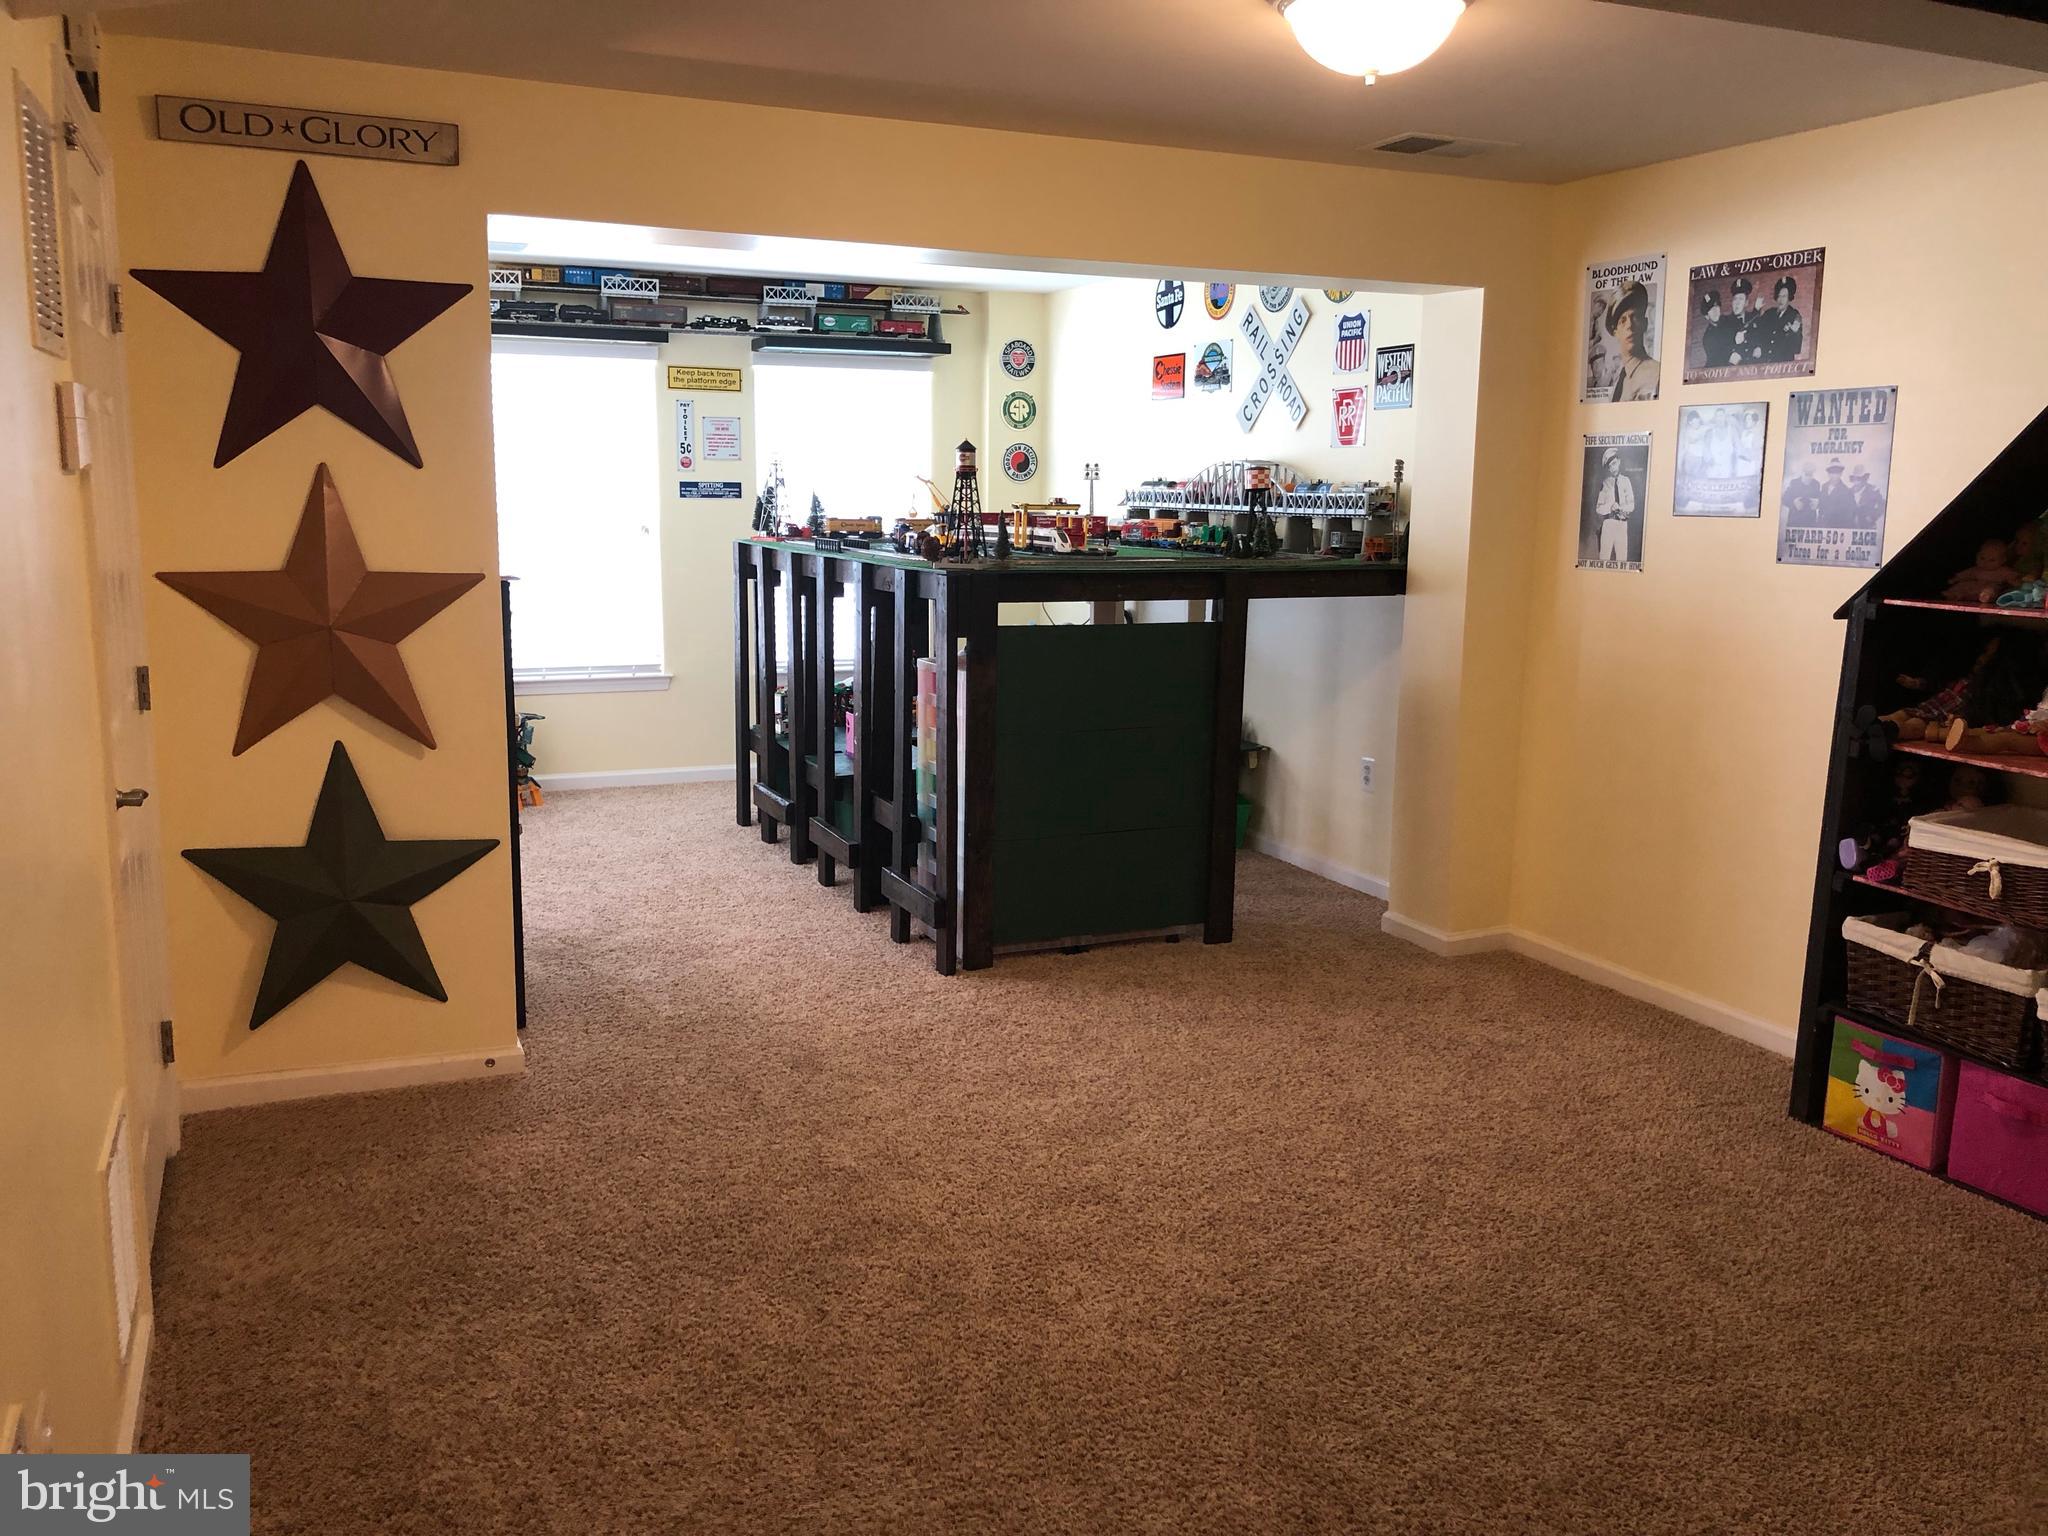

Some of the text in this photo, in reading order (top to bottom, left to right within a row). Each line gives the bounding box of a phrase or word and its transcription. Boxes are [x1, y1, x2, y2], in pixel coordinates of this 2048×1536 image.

[179, 103, 439, 155] OLD GLORY
[1592, 260, 1658, 279] BLOODHOUND
[1690, 264, 1718, 280] LAW
[1720, 263, 1730, 276] &
[1595, 279, 1608, 289] OF
[1156, 288, 1184, 309] Santa Fe
[1342, 319, 1362, 329] UNION
[1341, 328, 1363, 338] PACIFIC
[1005, 341, 1033, 356] SEABOARD
[676, 368, 696, 377] Keep
[1006, 363, 1032, 377] RAILWAY
[1243, 308, 1303, 422] CROSSING
[1243, 312, 1302, 422] RAIL ROAD
[1378, 351, 1413, 379] WESTERN
[719, 378, 737, 386] edge
[1376, 377, 1411, 404] PACIFIC
[1796, 390, 1888, 426] WANTED
[1828, 428, 1848, 440] FOR
[1810, 441, 1865, 455] VAGRANCY
[1851, 530, 1878, 546] EACH
[1788, 543, 1872, 561] Three for a dollar
